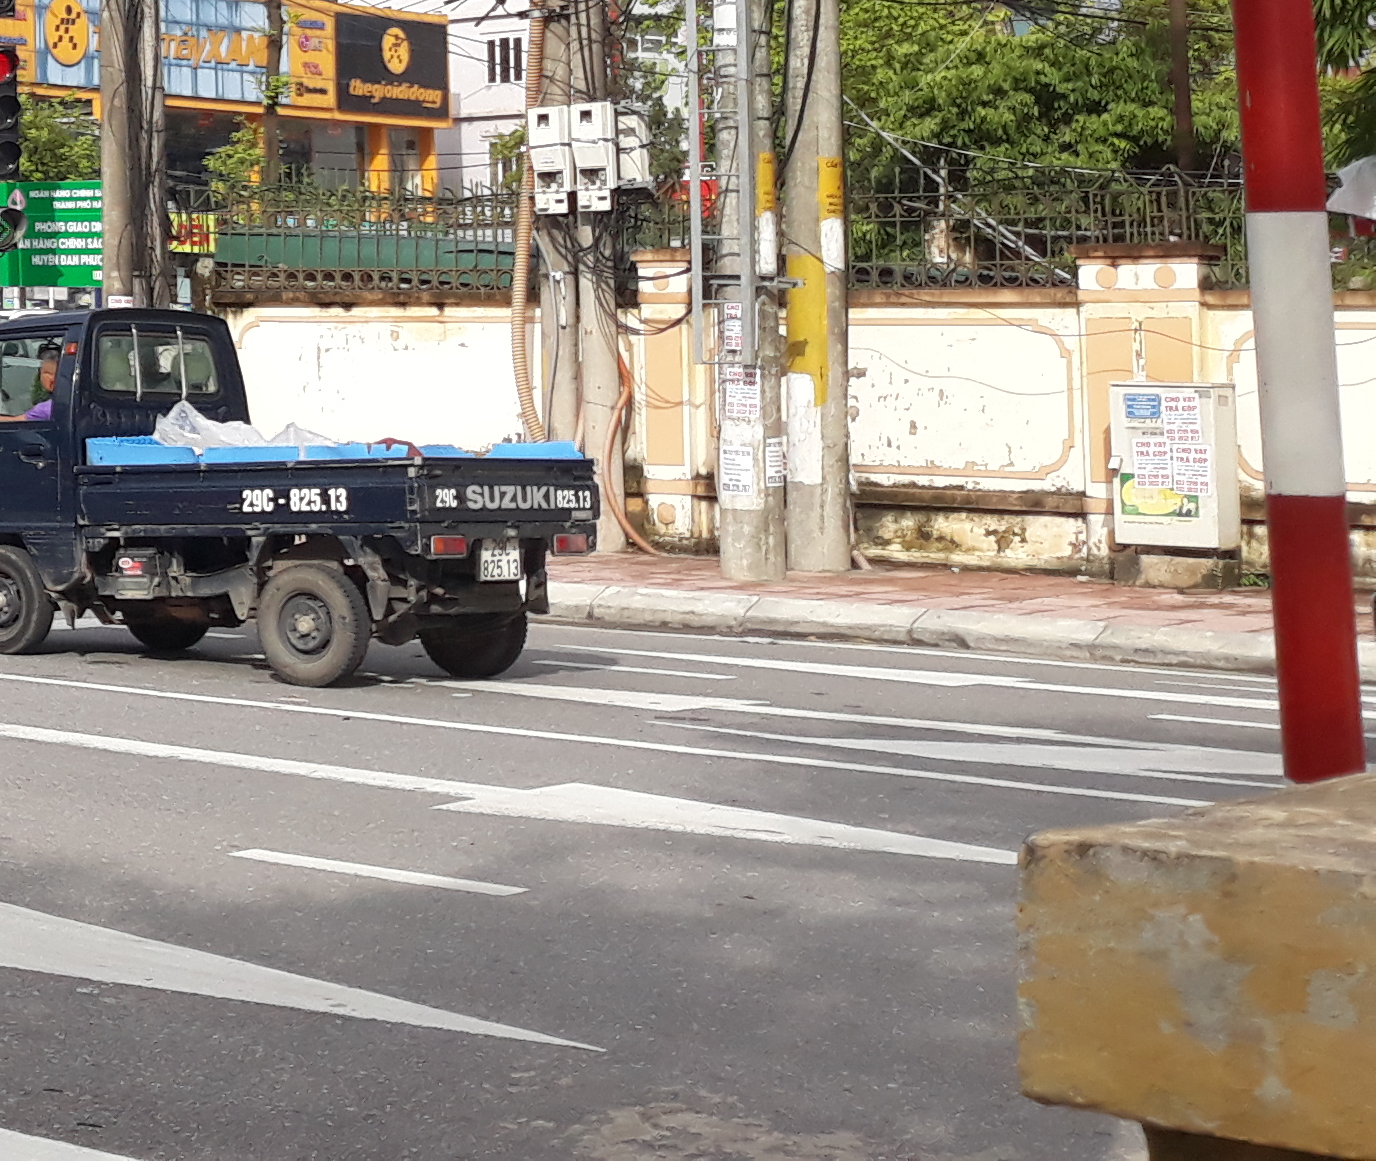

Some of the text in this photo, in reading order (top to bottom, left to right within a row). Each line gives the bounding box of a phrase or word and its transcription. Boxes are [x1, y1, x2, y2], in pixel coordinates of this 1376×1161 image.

[202, 29, 269, 67] XAN
[349, 77, 443, 109] thegioididong
[66, 221, 90, 233] GIAO
[242, 488, 274, 513] 29C
[289, 487, 348, 512] 825.13
[435, 484, 591, 510] 29C SUZUKI 825.13
[483, 558, 519, 578] 825.13
